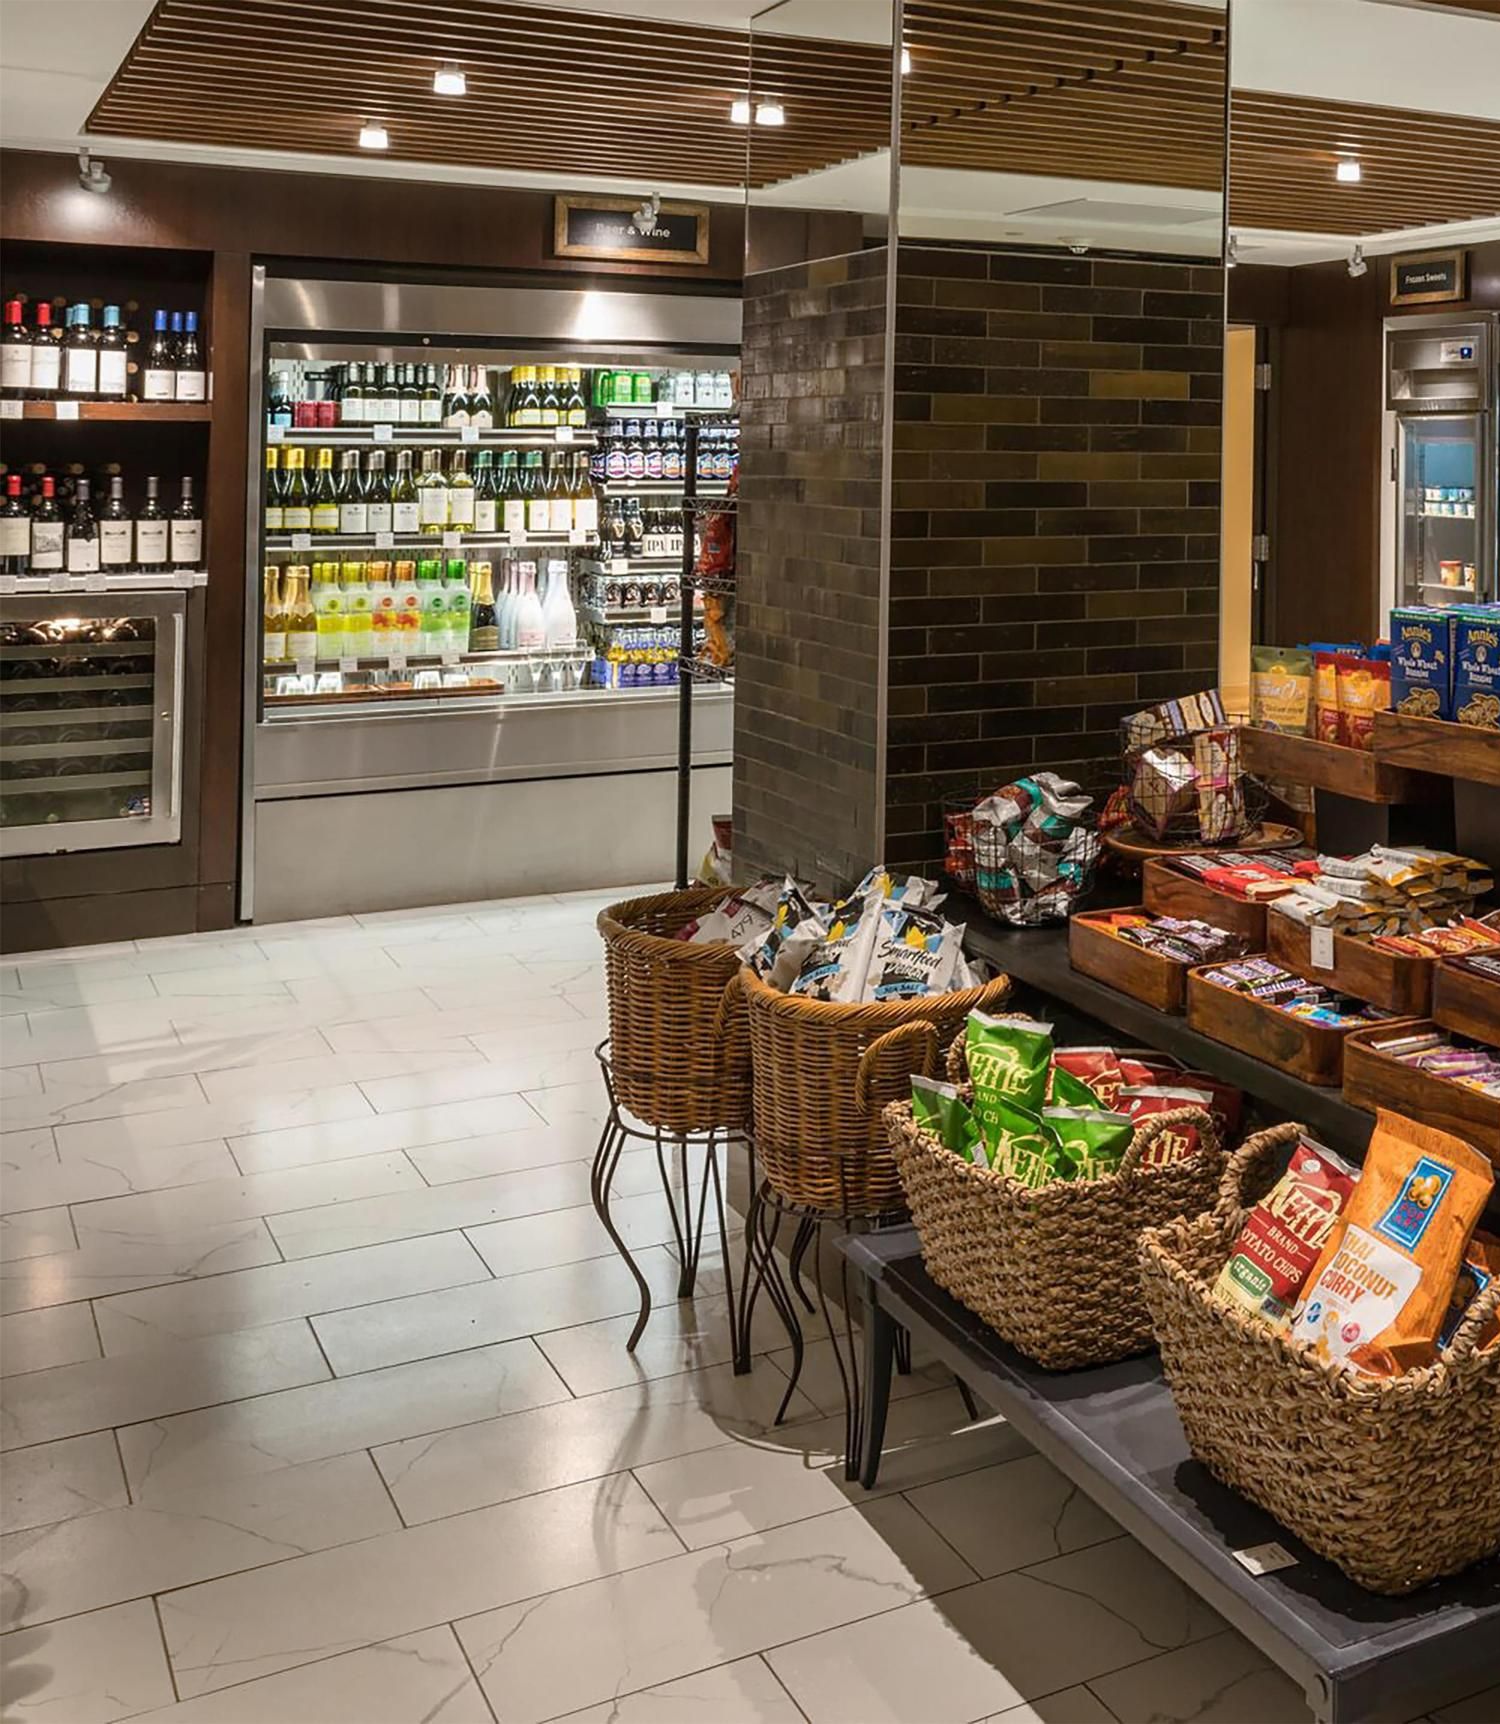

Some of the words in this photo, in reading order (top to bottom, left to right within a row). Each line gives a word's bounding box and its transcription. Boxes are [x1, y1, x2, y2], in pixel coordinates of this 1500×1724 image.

[595, 222, 624, 236] Beer
[627, 226, 635, 236] &
[639, 226, 671, 238] Wine
[1401, 624, 1432, 644] Annie's
[1467, 627, 1499, 648] Annie's
[1257, 1169, 1341, 1250] KETTL
[1266, 1225, 1299, 1255] BRAND
[1233, 1228, 1275, 1262] OTATO
[1272, 1256, 1303, 1284] CHIPS
